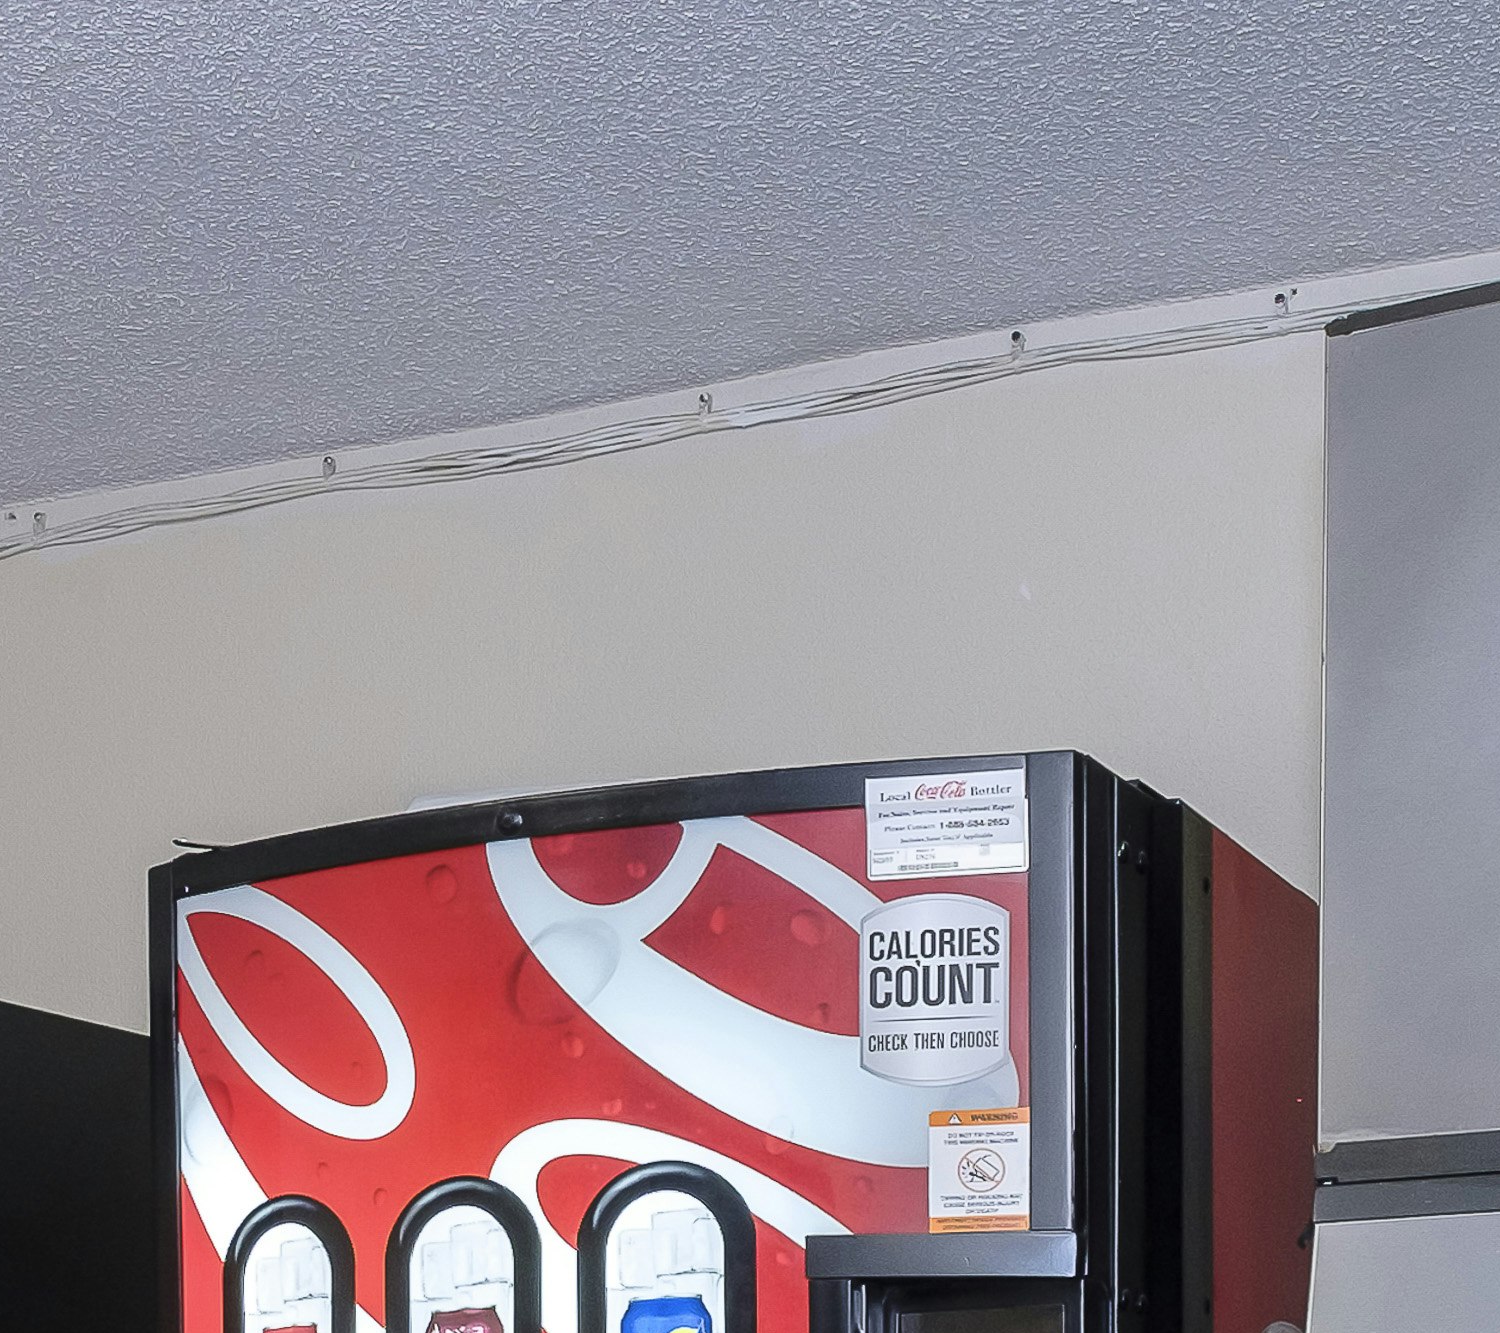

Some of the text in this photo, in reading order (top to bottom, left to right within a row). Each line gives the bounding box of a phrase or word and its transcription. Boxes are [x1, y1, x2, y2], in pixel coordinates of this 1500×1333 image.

[880, 781, 1013, 802] Local Coca-Cola Bottler
[869, 926, 1000, 961] CALORIES
[869, 962, 1000, 1009] COUNT
[868, 1030, 999, 1052] CHECK THEN CHOOSE
